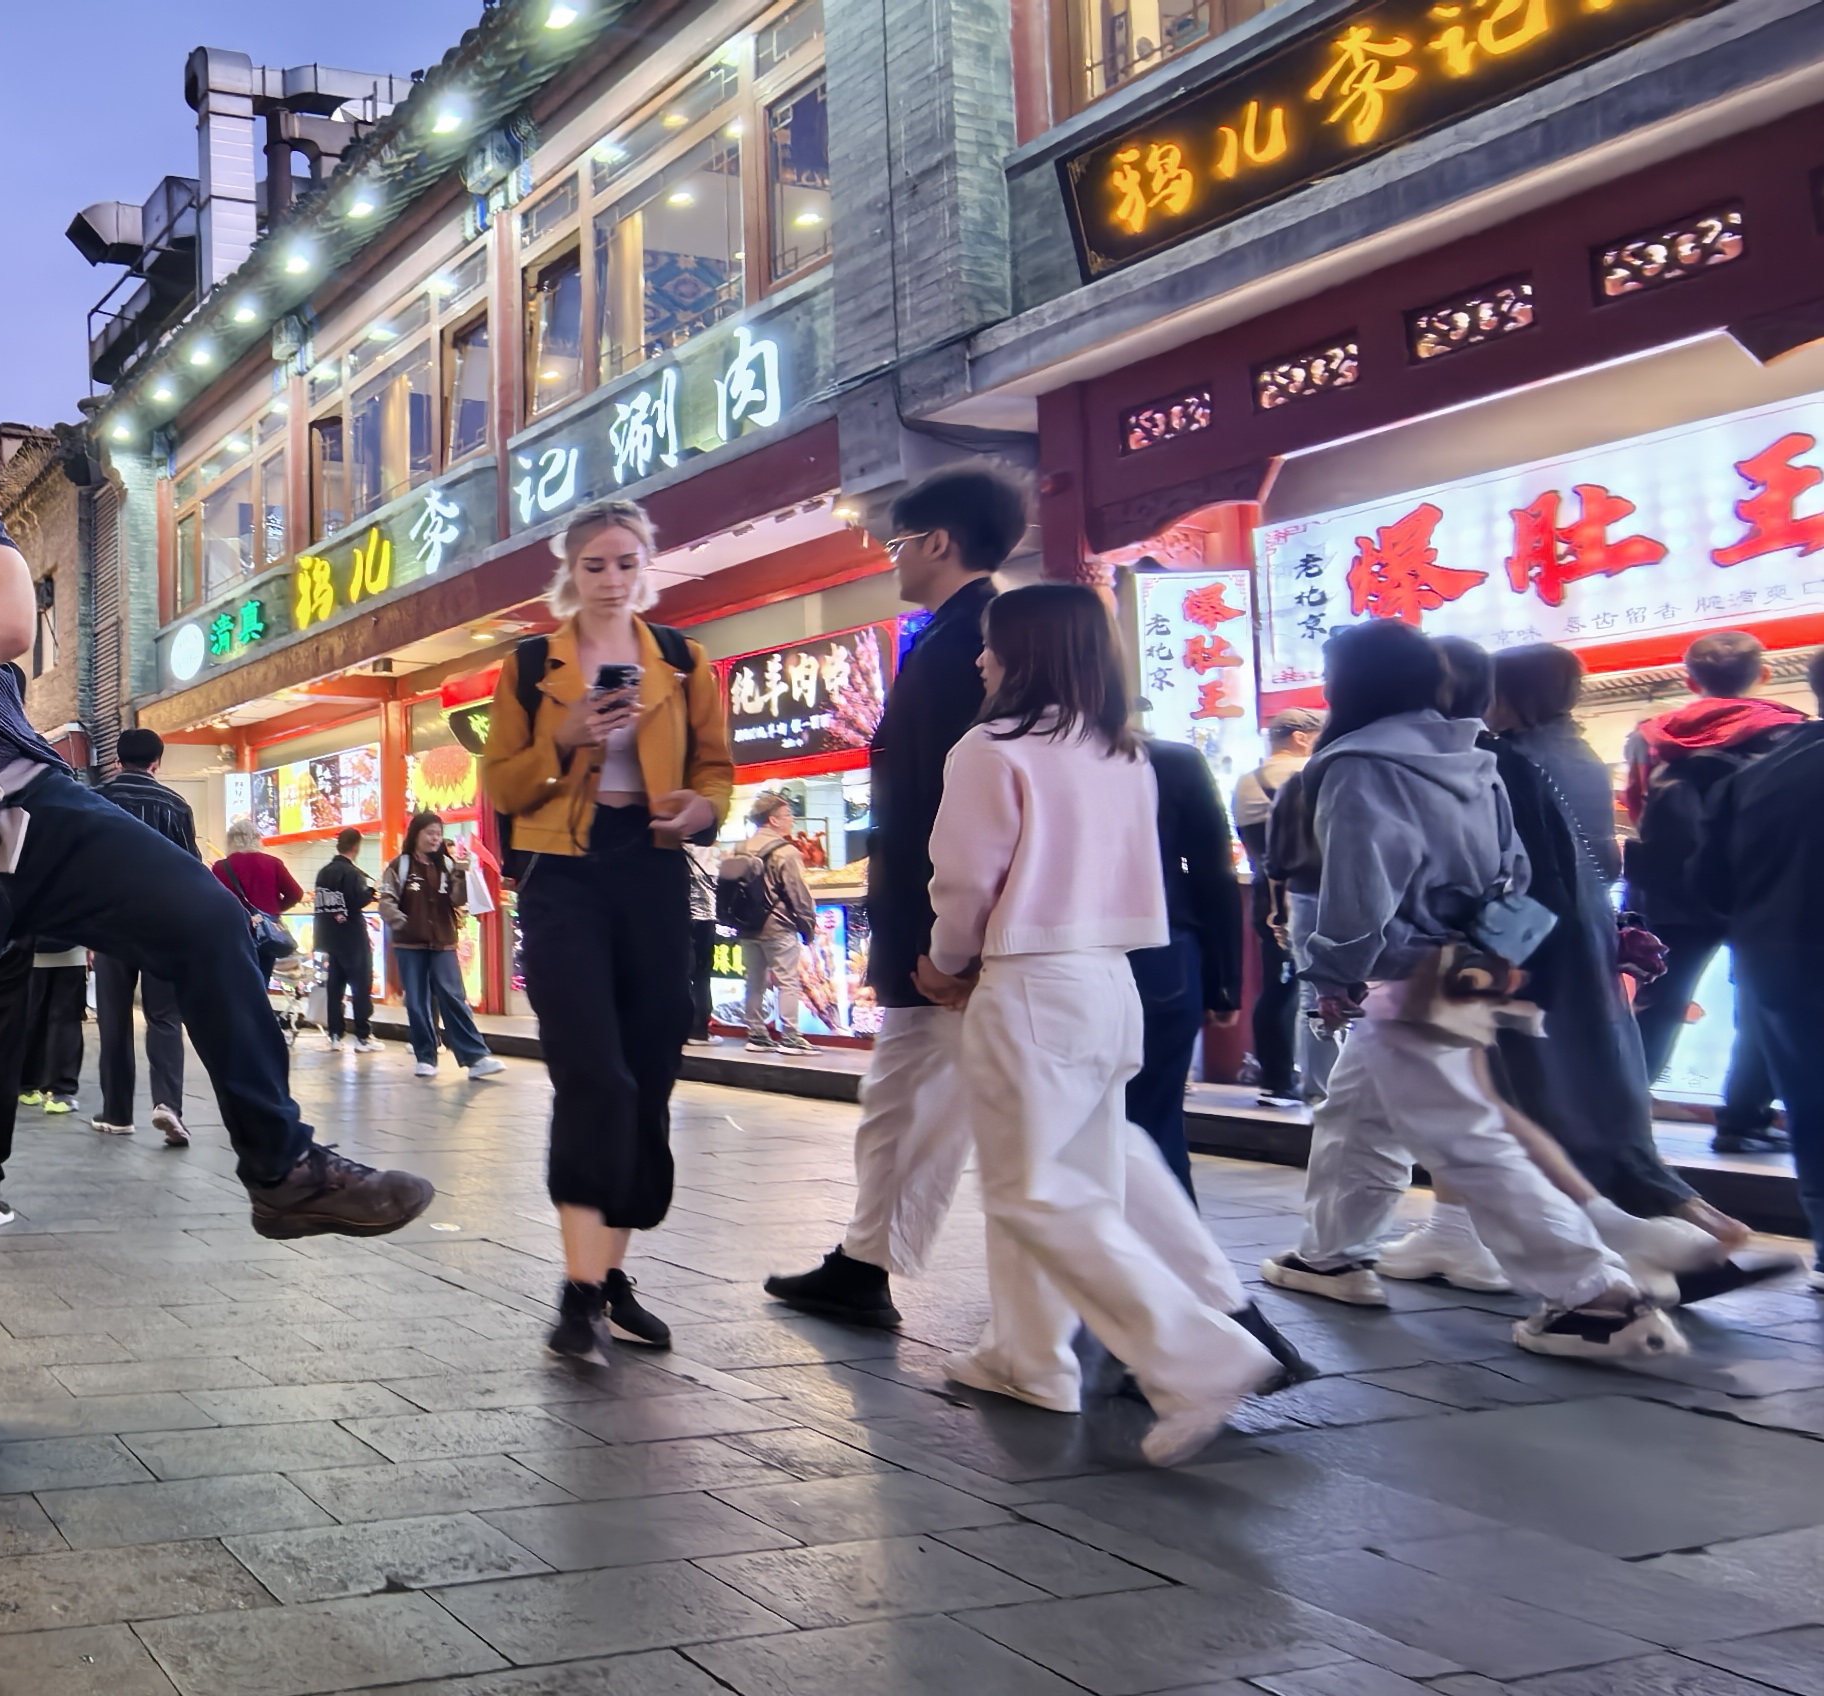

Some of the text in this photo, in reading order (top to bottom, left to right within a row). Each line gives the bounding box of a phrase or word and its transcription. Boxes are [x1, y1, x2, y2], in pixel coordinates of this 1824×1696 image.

[1112, 0, 1612, 233] 鸦儿李记
[1347, 432, 1824, 628] 爆肚王
[210, 600, 264, 655] 清真
[1145, 613, 1175, 691] 老北京
[1182, 582, 1247, 720] 爆肚王
[1294, 553, 1328, 640] 老北京
